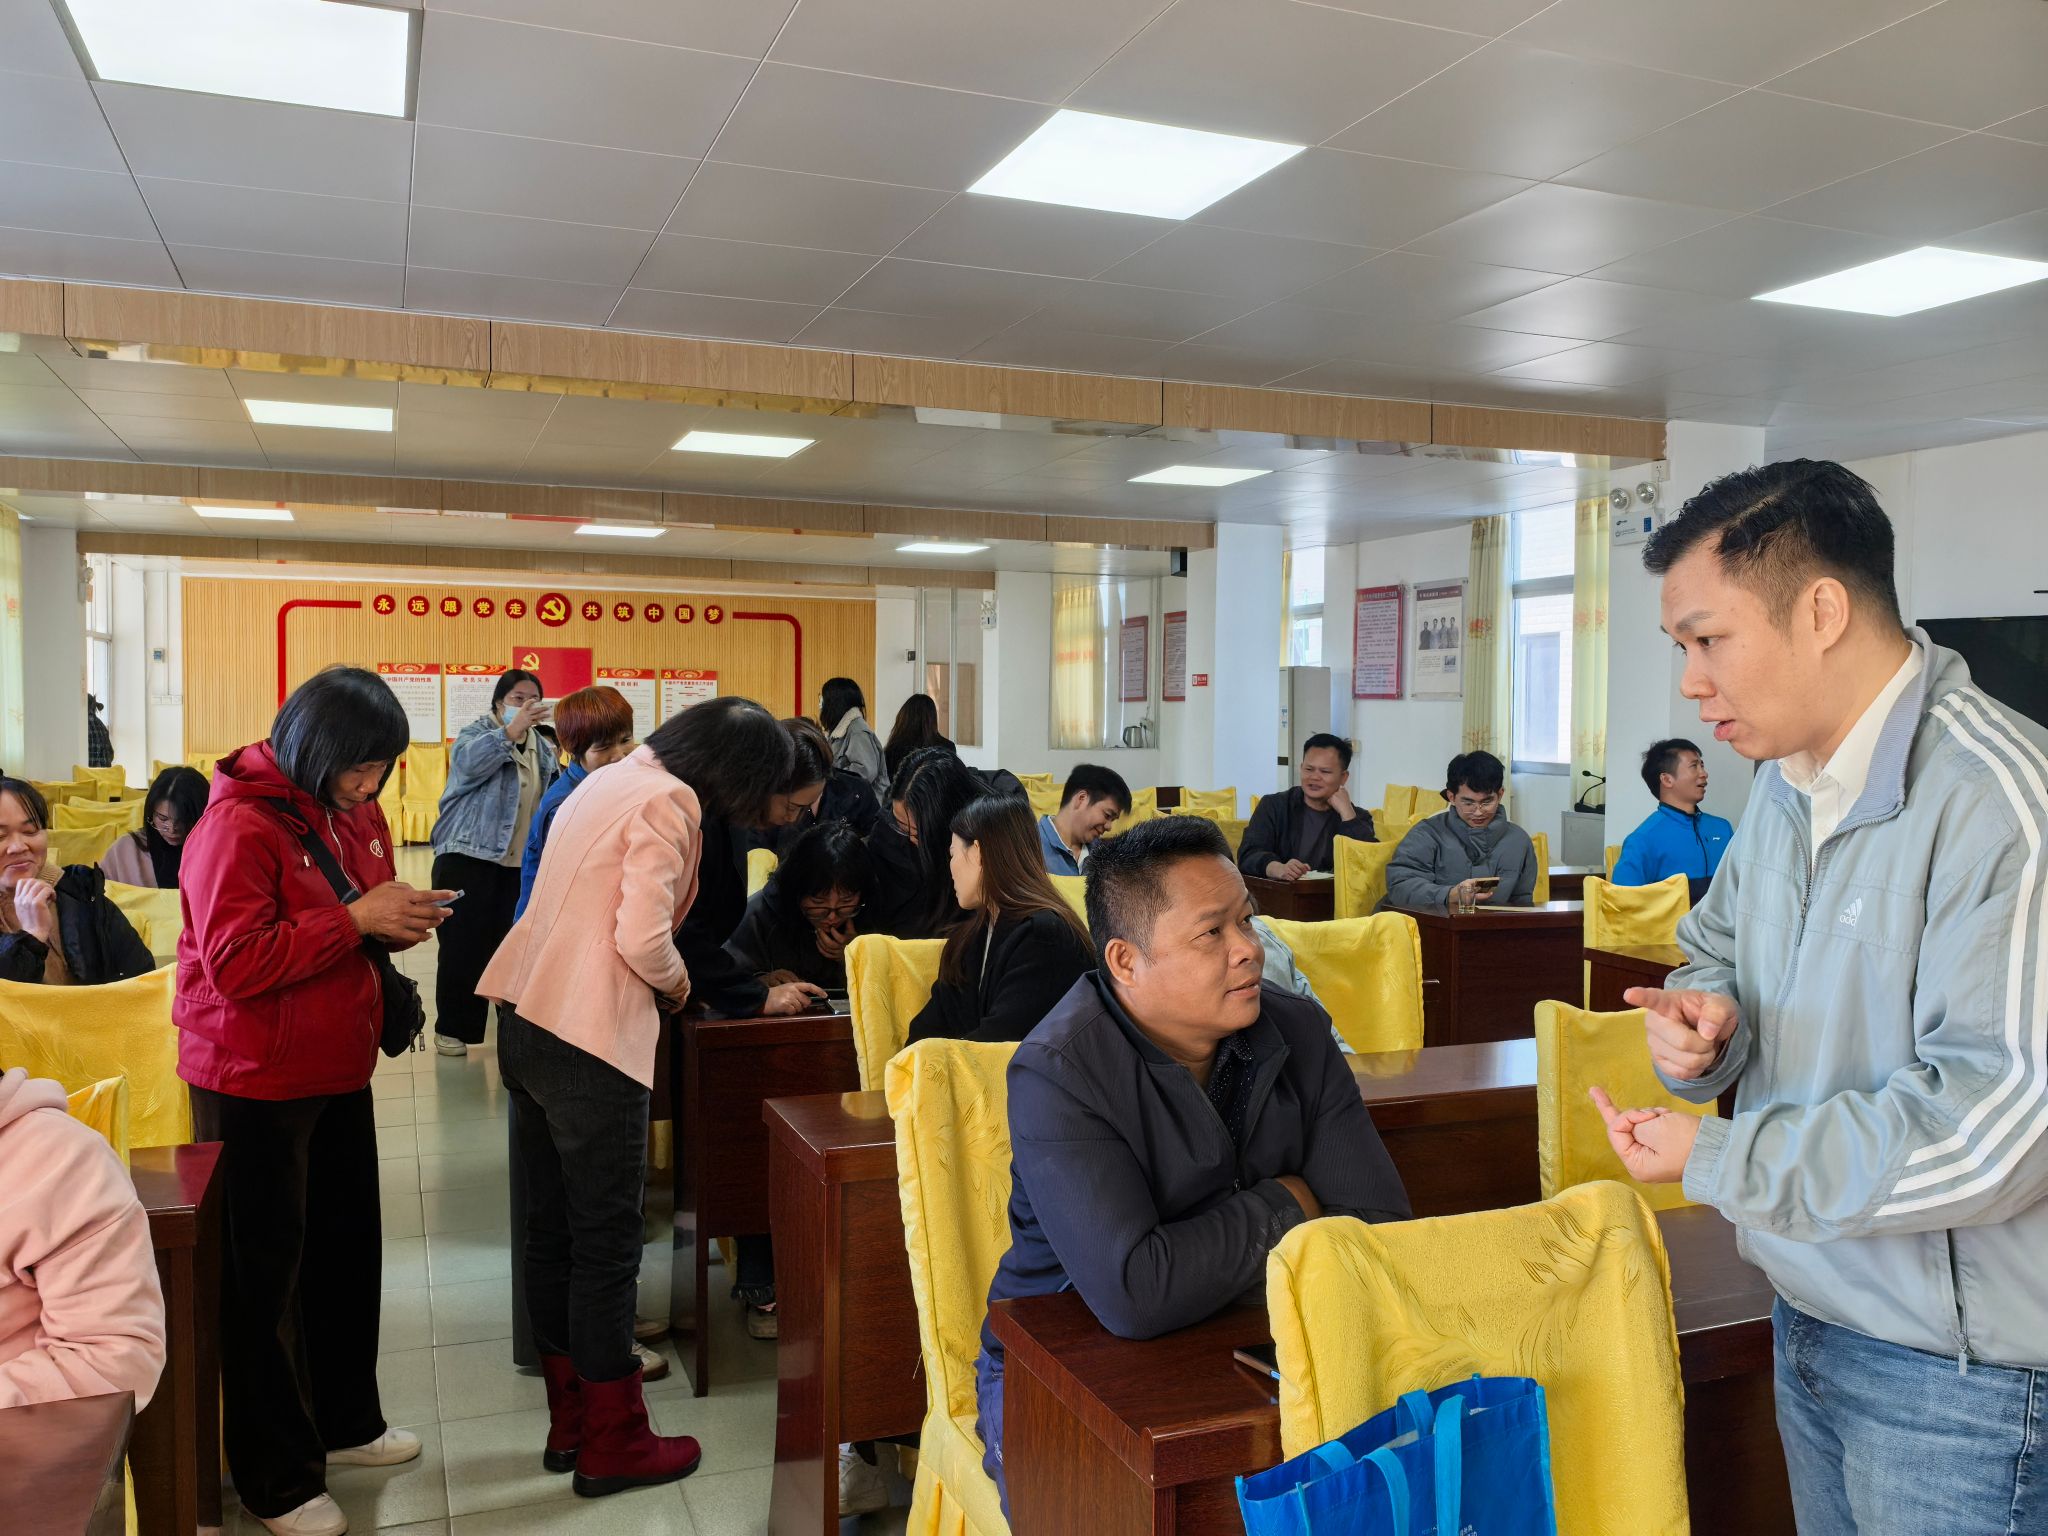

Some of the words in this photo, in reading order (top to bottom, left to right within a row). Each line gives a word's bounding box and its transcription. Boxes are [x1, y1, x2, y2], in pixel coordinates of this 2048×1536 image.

[376, 597, 523, 616] 永远跟党走
[585, 604, 721, 621] 共筑中国梦
